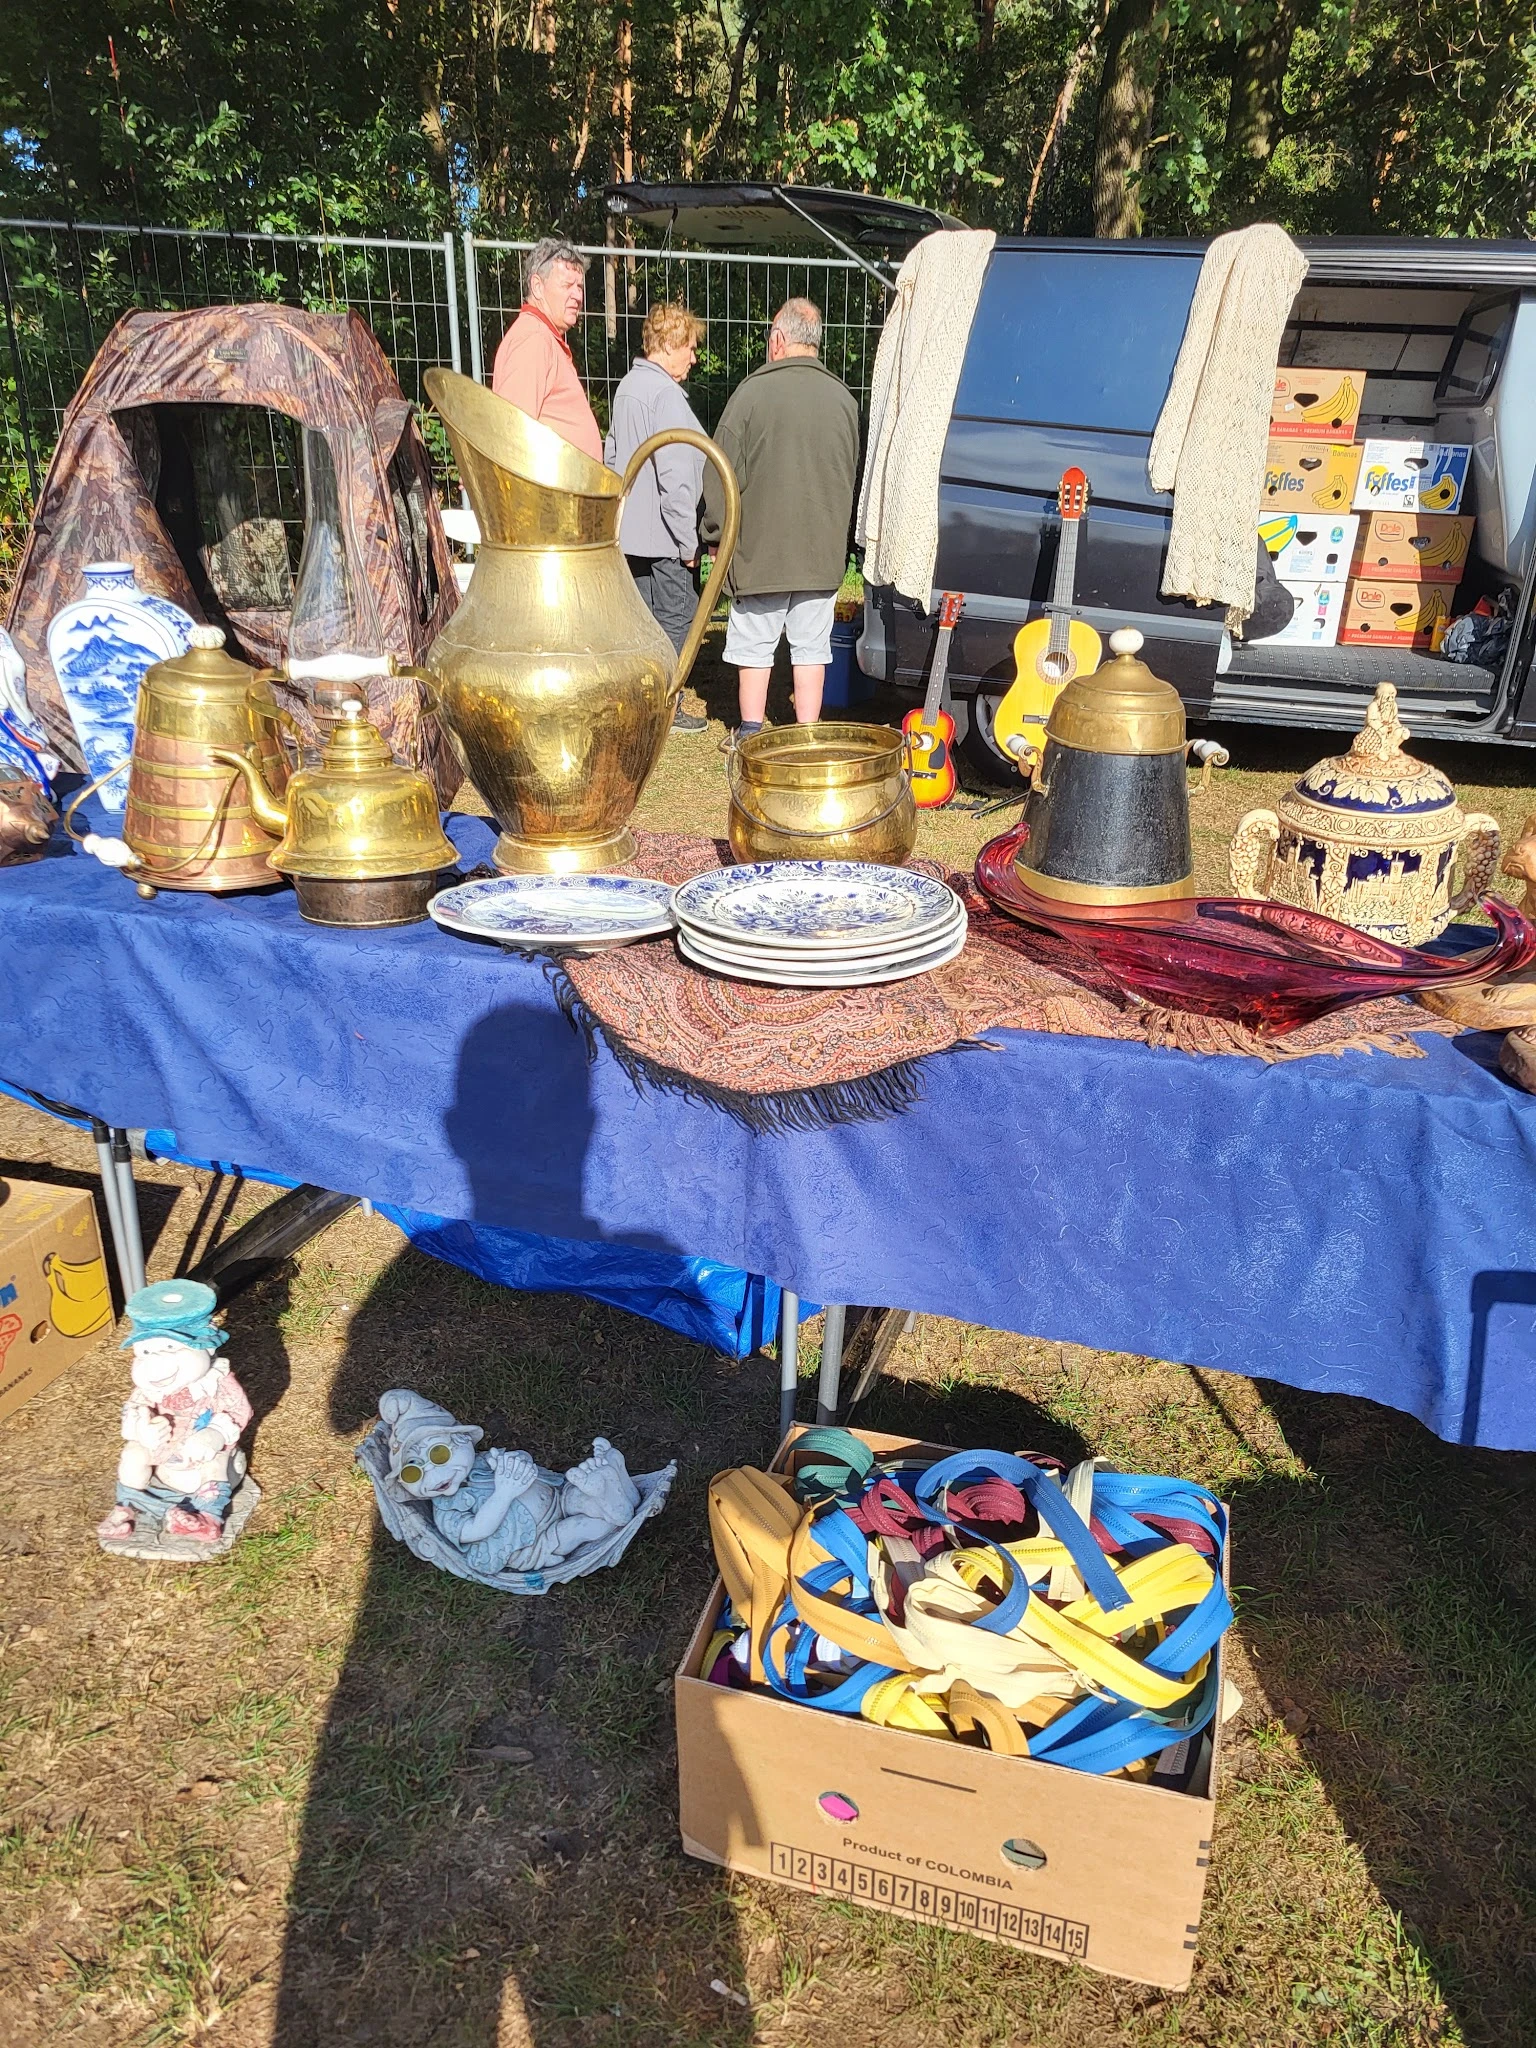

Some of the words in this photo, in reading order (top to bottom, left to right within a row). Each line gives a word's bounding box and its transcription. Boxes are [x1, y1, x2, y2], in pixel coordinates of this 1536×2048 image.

[1380, 523, 1401, 533] Dole
[1361, 591, 1382, 600] Dole
[843, 1837, 902, 1862] Product
[906, 1856, 922, 1866] of
[925, 1859, 1013, 1891] COLOMBIA
[778, 1852, 786, 1870] 1
[797, 1857, 807, 1875] 2
[817, 1862, 827, 1880] 3
[837, 1868, 848, 1886] 4
[858, 1873, 867, 1891] 5
[878, 1878, 888, 1896] 6
[899, 1884, 909, 1901] 7
[920, 1890, 930, 1908] 8
[941, 1895, 950, 1913] 9
[960, 1900, 975, 1920] 10
[981, 1906, 996, 1926] 11
[1002, 1911, 1018, 1932] 12
[1024, 1917, 1039, 1937] 13
[1045, 1922, 1061, 1943] 14
[1068, 1928, 1084, 1949] 15
